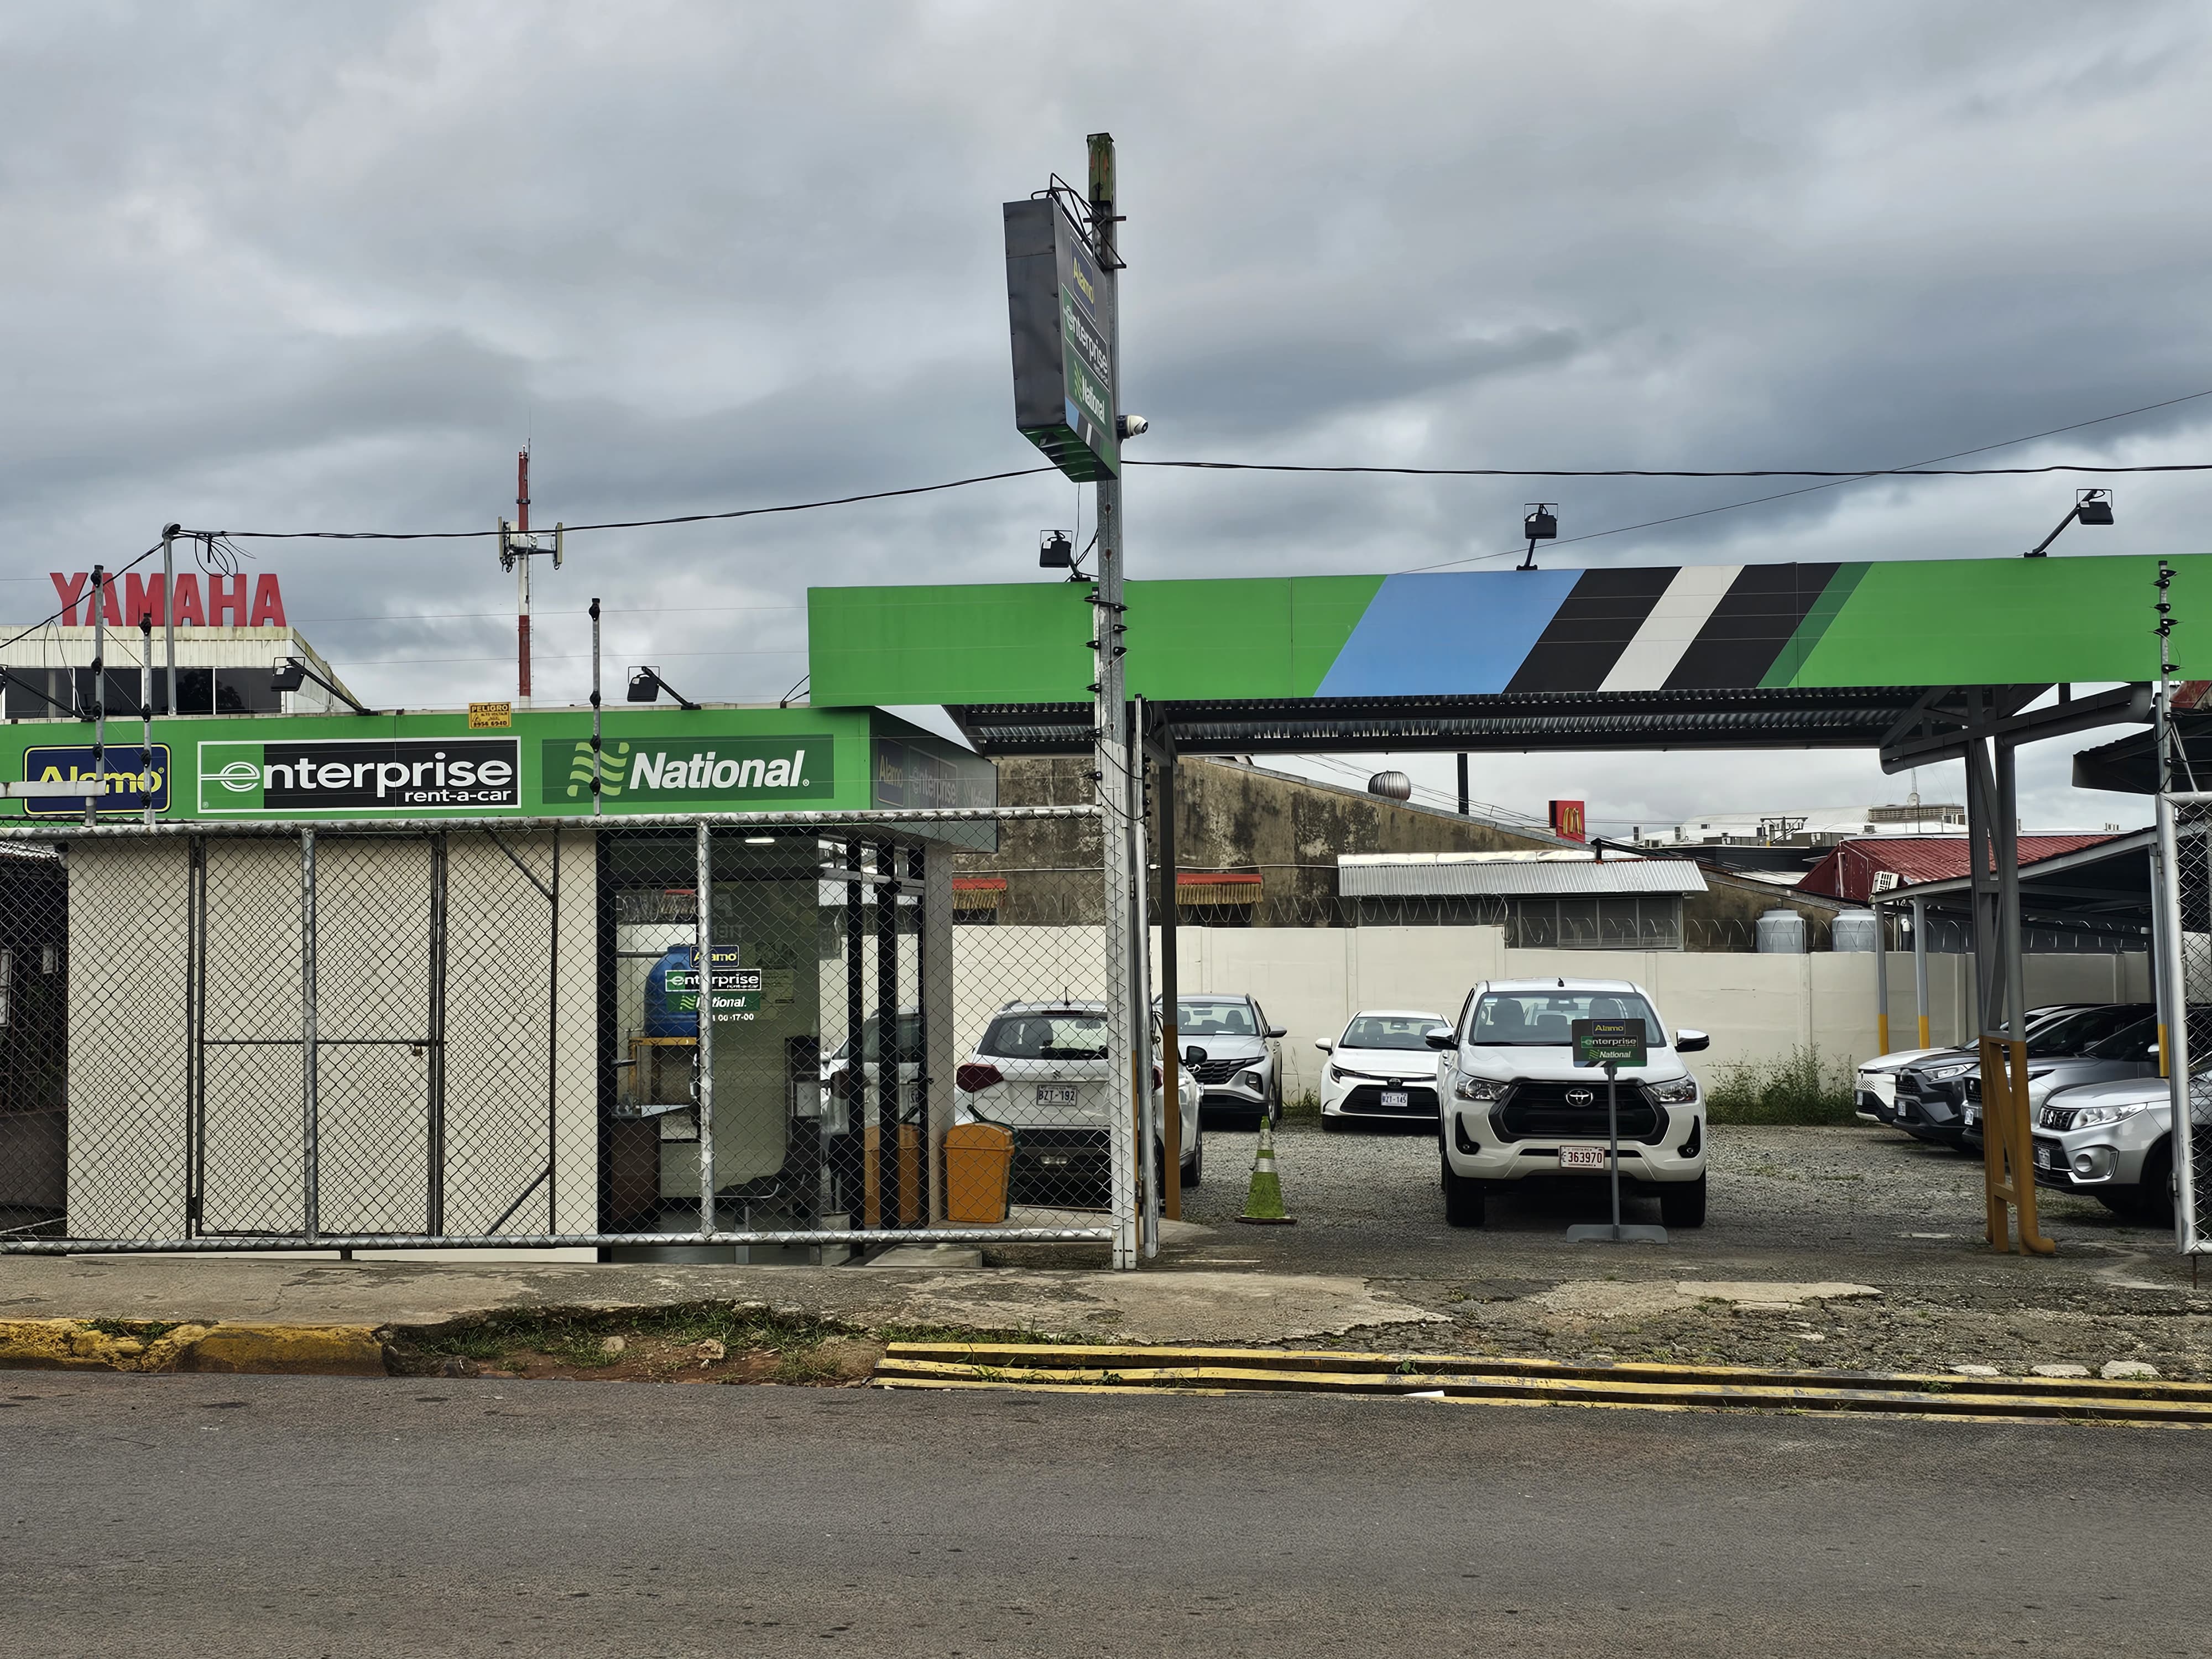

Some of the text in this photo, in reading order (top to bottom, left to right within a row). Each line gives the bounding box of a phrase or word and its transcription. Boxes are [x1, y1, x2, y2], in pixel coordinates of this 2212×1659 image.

[1073, 257, 1094, 304] Alamo
[1063, 305, 1108, 373] enterprise
[1082, 375, 1105, 425] National
[50, 572, 286, 627] YAMAHA
[219, 752, 513, 797] enterprise
[629, 750, 806, 790] National
[879, 755, 903, 788] Alamo
[912, 766, 957, 808] enterprise
[405, 789, 512, 802] rent-a-car
[693, 952, 737, 961] amo
[671, 974, 759, 987] entrprise
[696, 997, 745, 1008] tional
[1039, 1091, 1075, 1100] BZT-192
[1568, 1152, 1602, 1163] 363970
